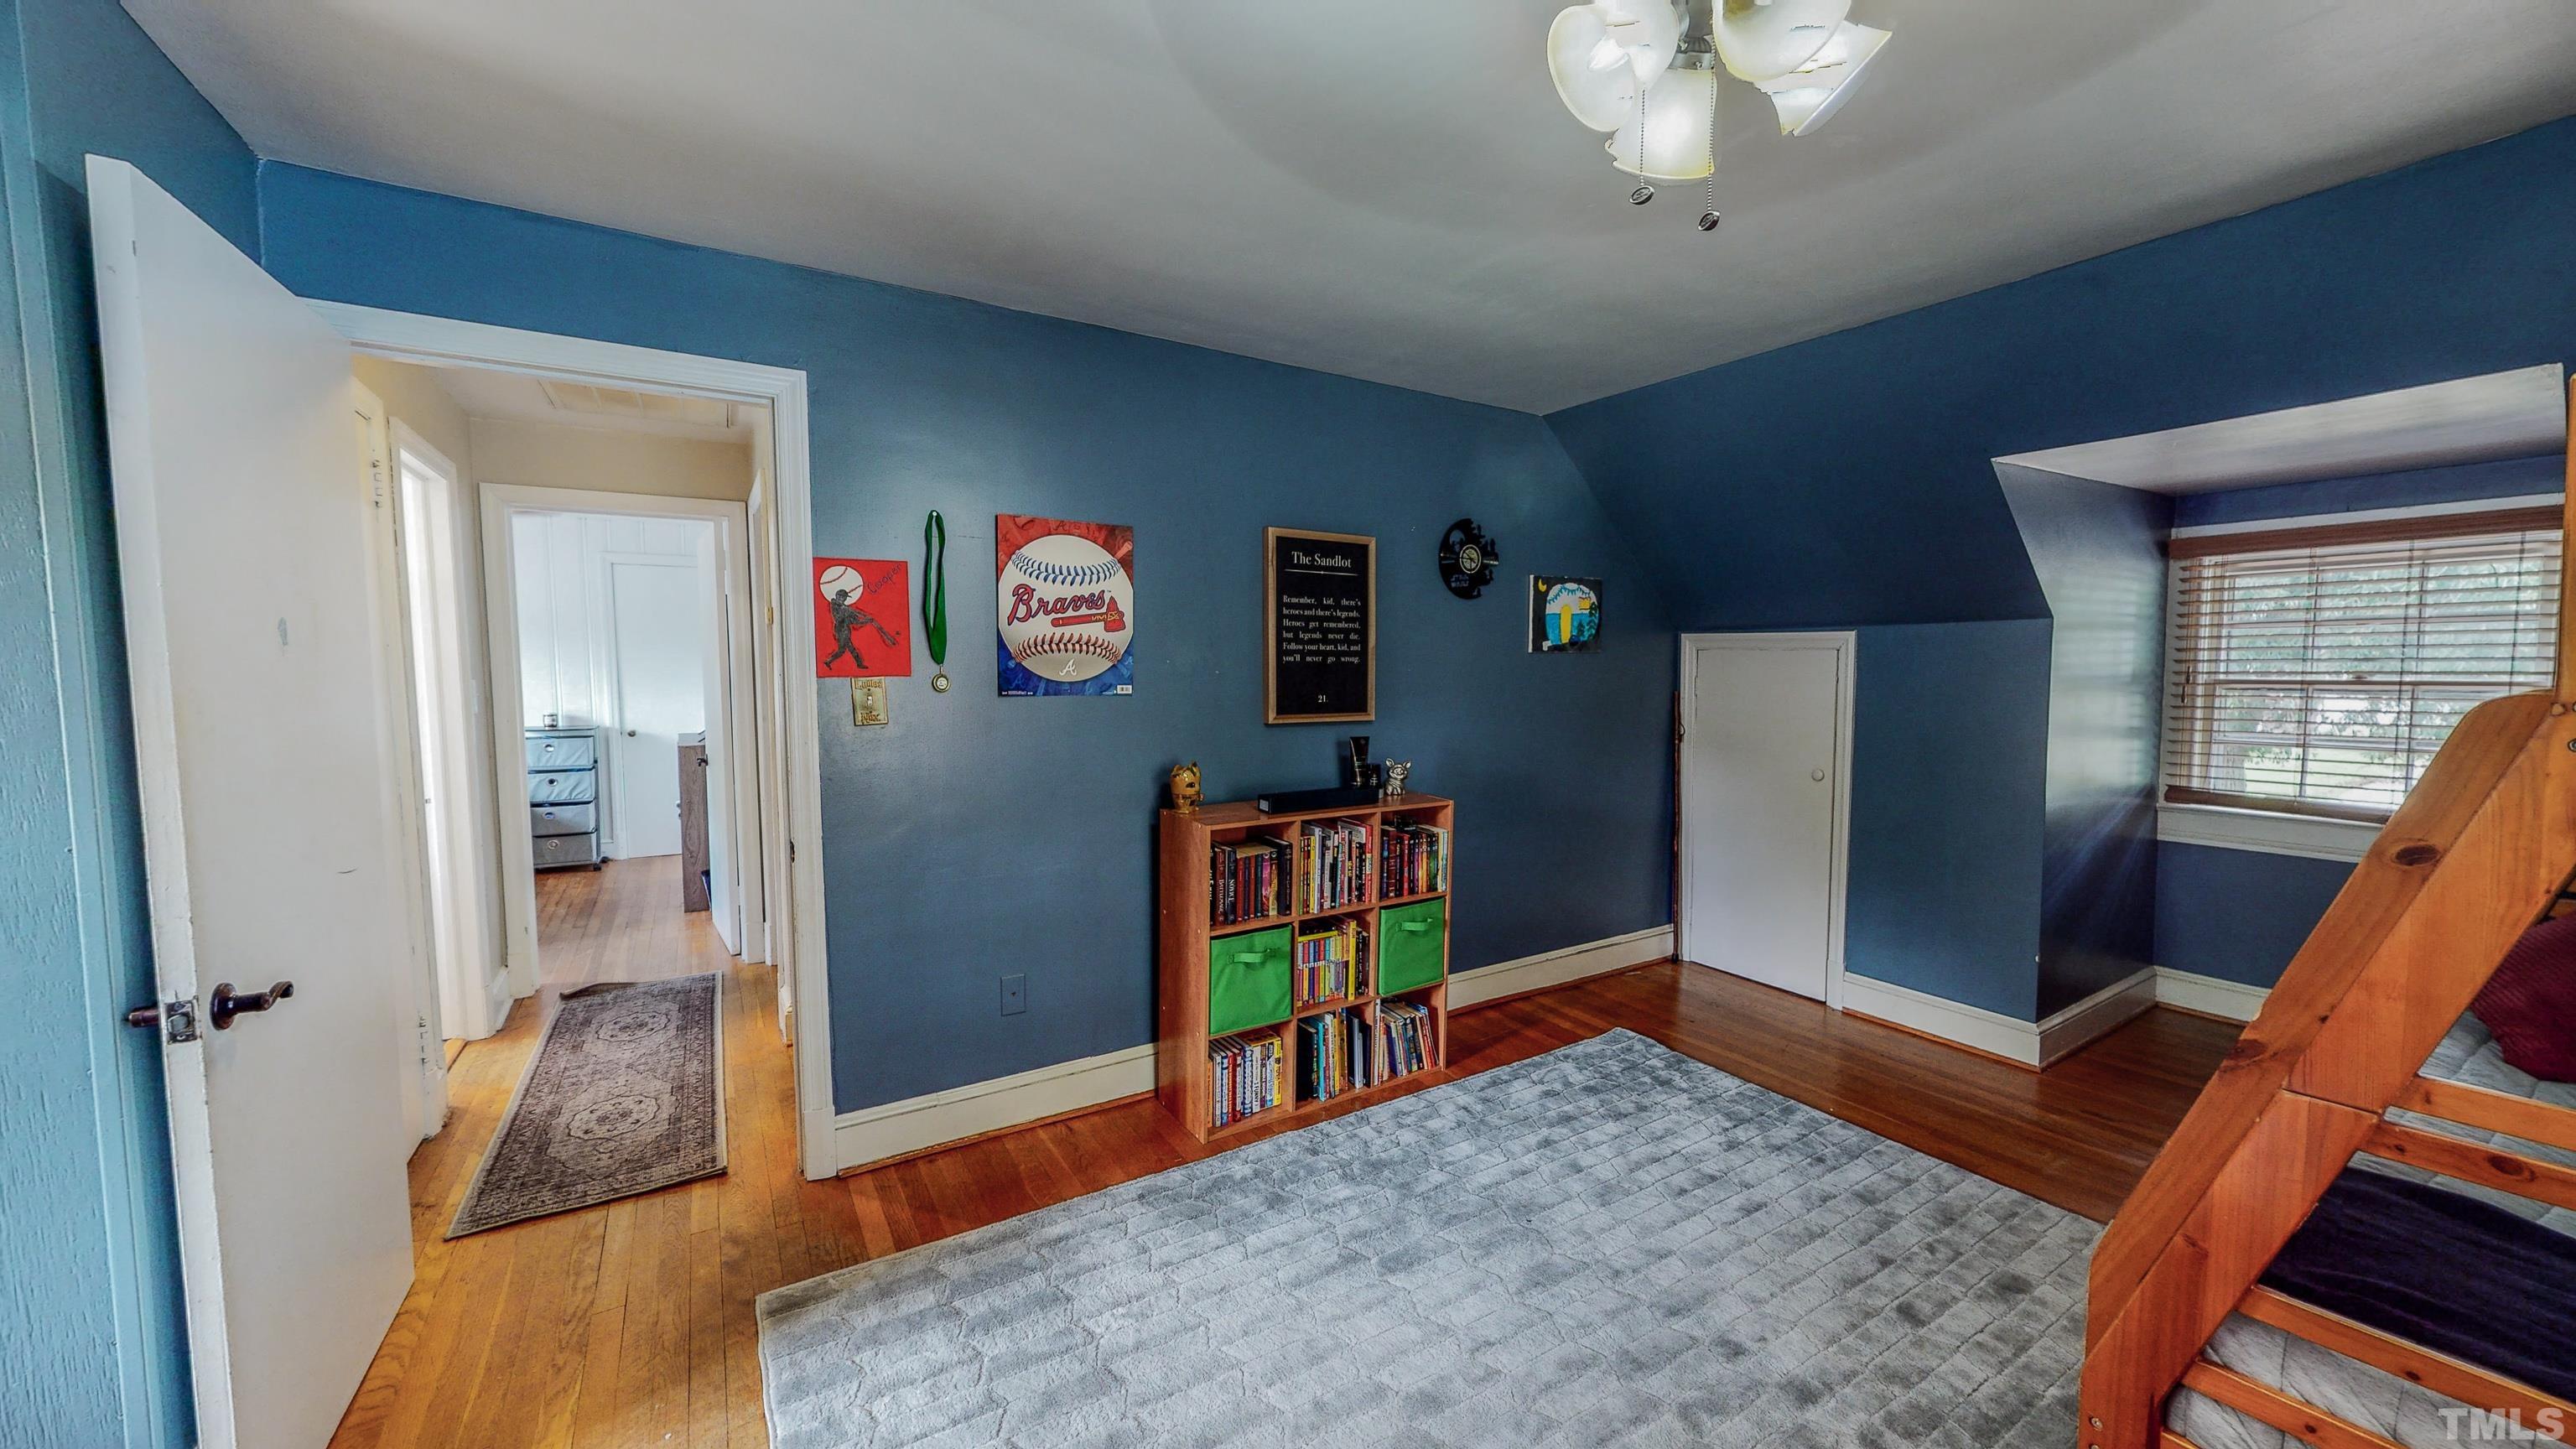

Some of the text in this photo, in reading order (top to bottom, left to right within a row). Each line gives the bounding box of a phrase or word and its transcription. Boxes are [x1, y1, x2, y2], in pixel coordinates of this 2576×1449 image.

[1291, 551, 1352, 568] The Sandlot
[1007, 584, 1105, 626] Braves
[1323, 597, 1335, 605] kid,
[1283, 606, 1303, 615] heroes
[1316, 608, 1336, 616] there's
[1283, 618, 1305, 627] Heroes
[1299, 631, 1322, 641] legends
[1283, 641, 1303, 650] Follow
[1304, 644, 1318, 652] your
[1337, 643, 1349, 652] kid,
[1283, 654, 1301, 663] you'll
